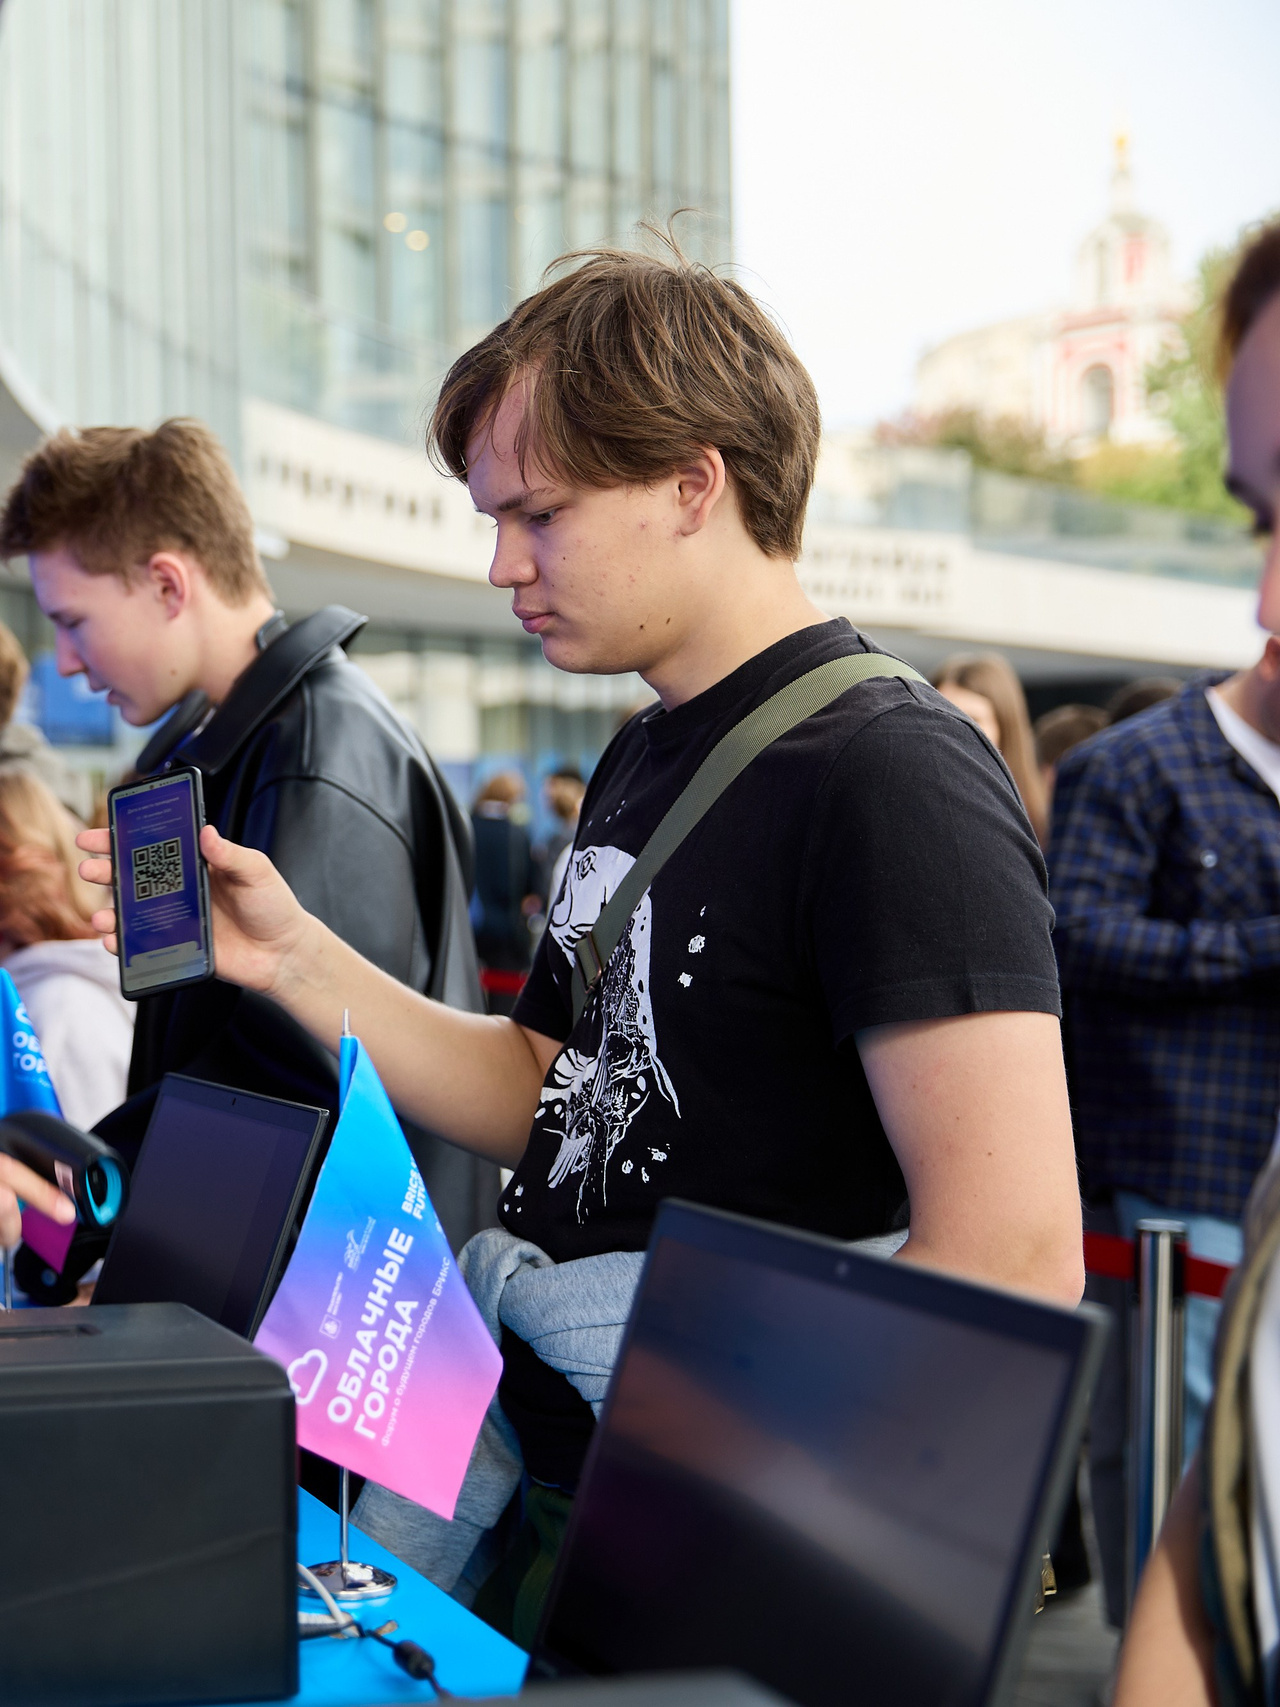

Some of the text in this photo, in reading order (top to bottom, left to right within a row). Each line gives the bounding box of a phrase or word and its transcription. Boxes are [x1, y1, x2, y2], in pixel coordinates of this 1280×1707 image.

[401, 1169, 419, 1214] BRICS
[327, 1227, 414, 1424] ОБЛАЧНЫЕ
[354, 1300, 419, 1440] ГОРОДА
[381, 1256, 450, 1447] Форум о будущем городов БРИКС
